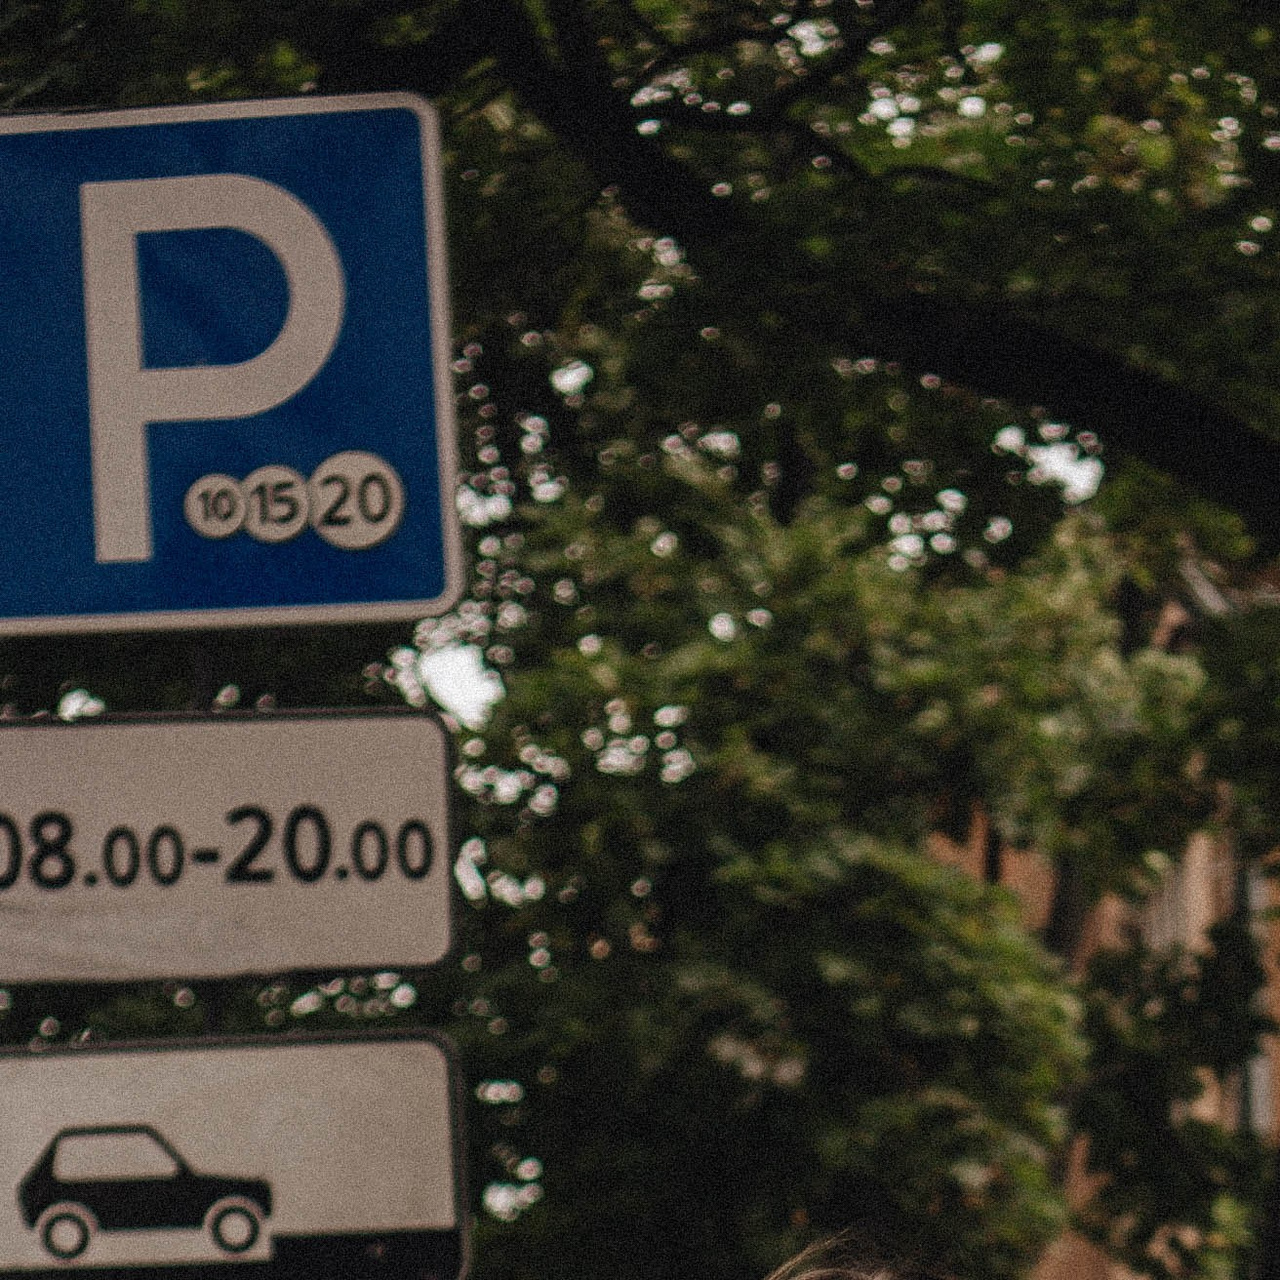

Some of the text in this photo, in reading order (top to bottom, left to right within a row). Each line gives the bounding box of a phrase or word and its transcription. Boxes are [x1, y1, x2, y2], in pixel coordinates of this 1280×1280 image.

[82, 175, 344, 562] P
[197, 473, 392, 526] 10 15 20
